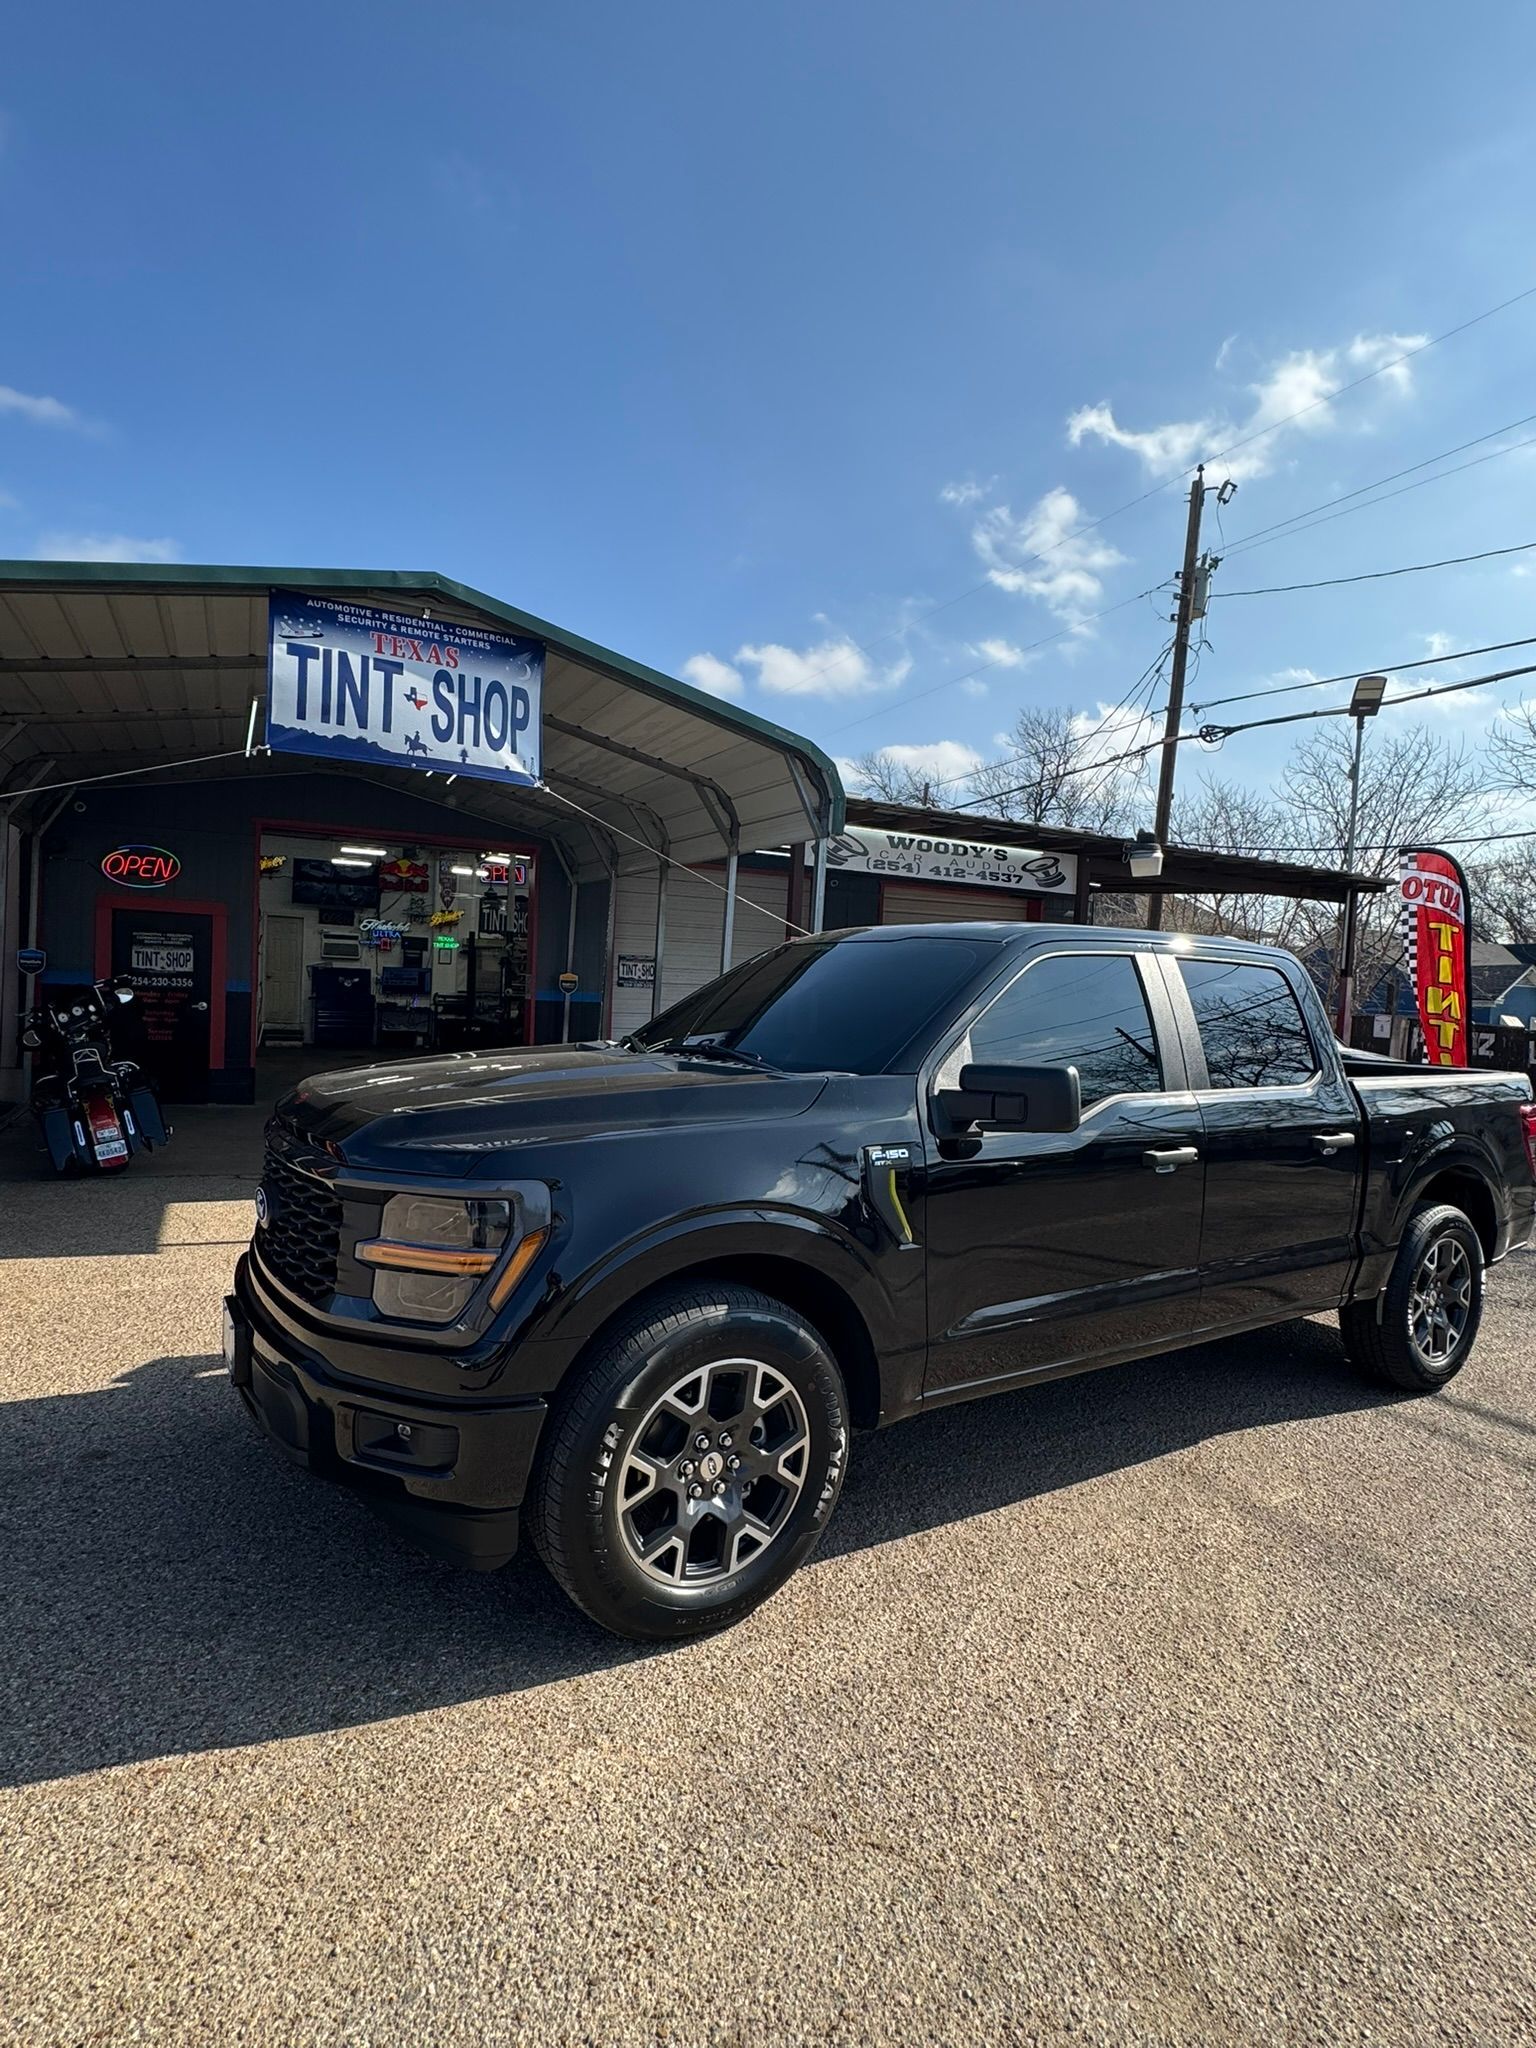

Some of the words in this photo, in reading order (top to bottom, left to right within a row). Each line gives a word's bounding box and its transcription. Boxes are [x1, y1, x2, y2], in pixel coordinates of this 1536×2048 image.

[307, 600, 372, 617] AUTOMOTIVE
[382, 613, 447, 632] RESIDENTIAL
[455, 627, 516, 646] COMMERCIAL
[338, 613, 387, 630] SECURITY
[390, 623, 397, 632] &
[401, 625, 440, 640] REMOTE
[443, 633, 491, 650] STARTERS
[370, 631, 460, 669] TEXAS
[286, 642, 403, 733] TINT
[431, 669, 530, 754] SHOP
[886, 835, 1008, 862] WOODY'S
[106, 855, 174, 879] OPEN
[865, 856, 921, 875] (254)
[929, 864, 1024, 885] 412-4537
[879, 850, 923, 864] CAR
[950, 858, 1016, 873] AUDIO
[483, 909, 507, 932] TINT
[372, 930, 401, 939] ULTRA
[135, 950, 160, 966] TINT
[166, 952, 191, 968] SHOP
[621, 963, 638, 976] TINT
[131, 977, 194, 988] 254-230-3356
[871, 1148, 909, 1160] F-150
